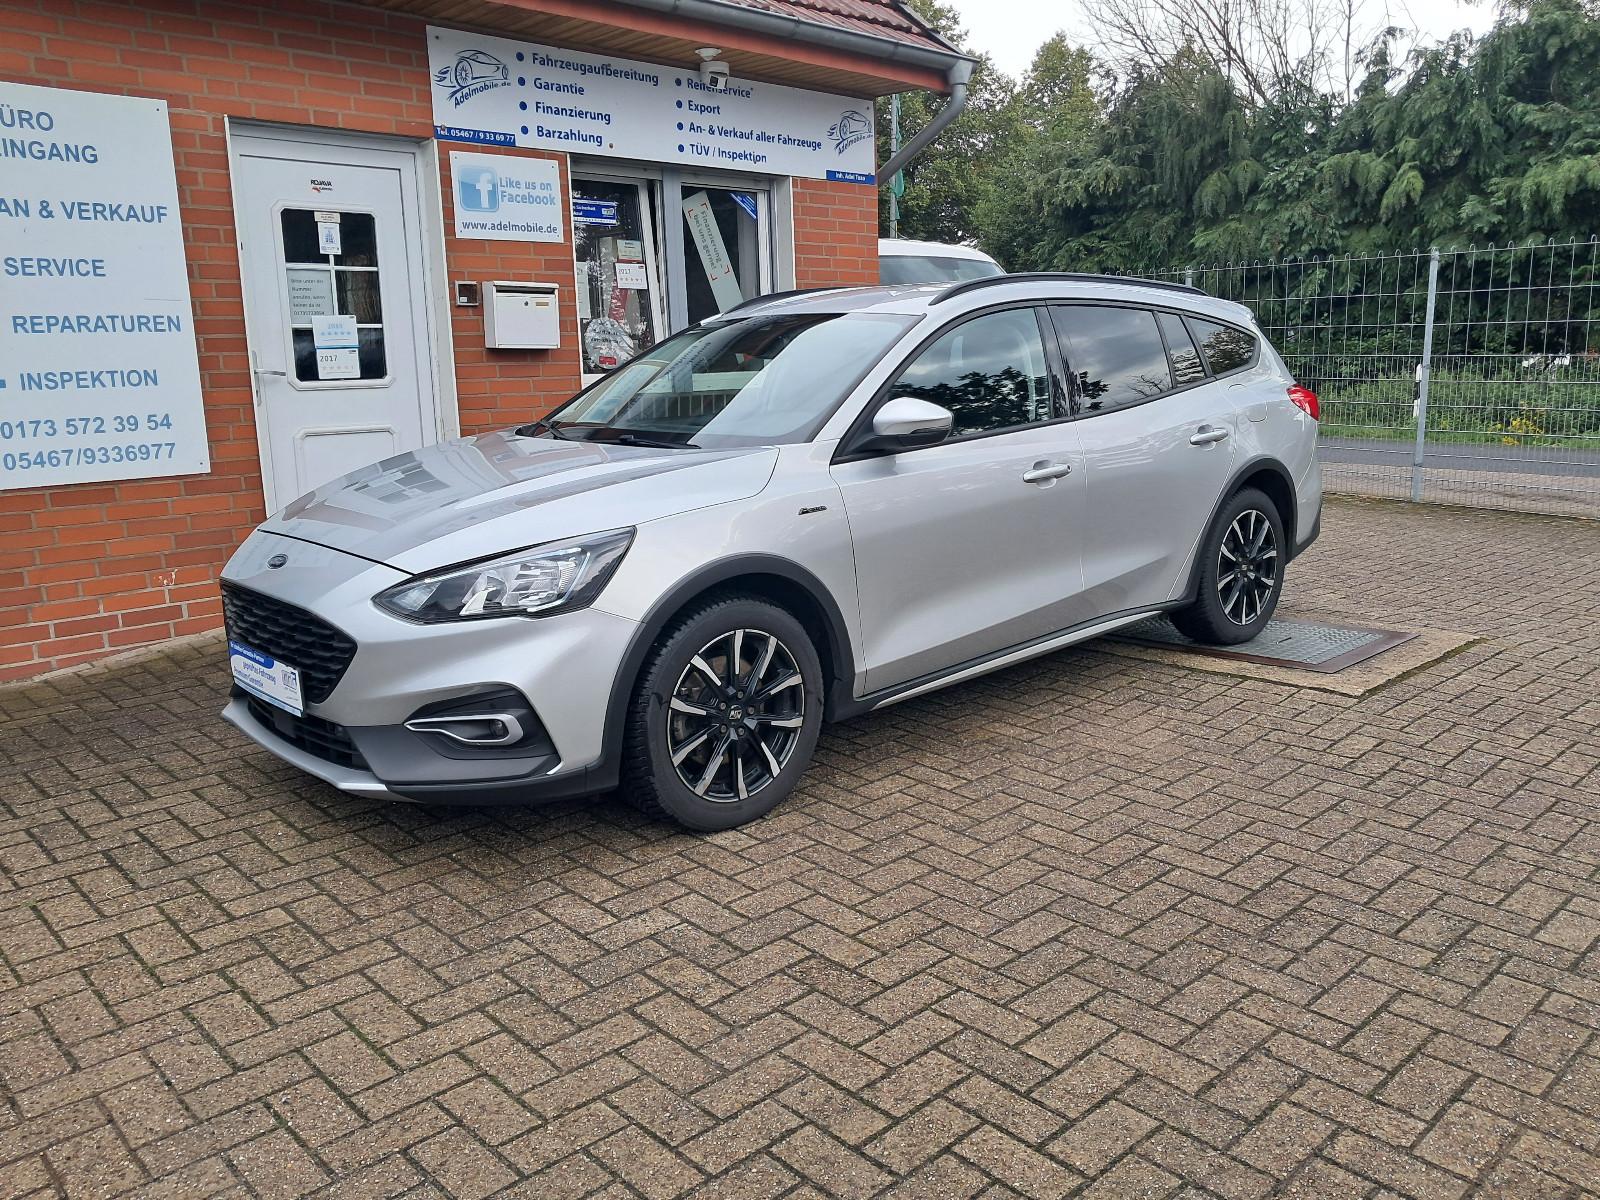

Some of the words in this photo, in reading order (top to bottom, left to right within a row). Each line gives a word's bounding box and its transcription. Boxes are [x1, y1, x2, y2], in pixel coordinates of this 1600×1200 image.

[532, 53, 659, 86] Fahrzeugaufbereitung
[453, 81, 512, 109] Adelmobile.de
[533, 77, 585, 95] Garantie
[535, 101, 611, 125] Finanzierung
[688, 99, 720, 115] Export
[451, 129, 474, 138] 05467
[536, 125, 603, 146] Barzahlung
[689, 122, 706, 134] An-
[708, 125, 716, 135] &
[717, 126, 753, 141] Verkauf
[755, 131, 776, 144] aller
[777, 135, 822, 150] Fahrzeuge
[0, 138, 98, 163] INGANG
[689, 143, 710, 157] TÜV
[718, 147, 767, 164] Inspektion
[499, 177, 521, 190] Like
[525, 181, 537, 191] us
[540, 182, 552, 192] on
[500, 191, 556, 206] Facebook
[0, 198, 30, 218] AN
[38, 200, 55, 219] &
[60, 200, 168, 224] VERKAUF
[462, 221, 558, 234] www.adelmobile.de
[4, 256, 107, 278] SERVICE
[12, 315, 182, 333] REPARATUREN
[20, 369, 159, 391] INSPEKTION
[0, 419, 57, 440] 0173
[65, 416, 107, 436] 572
[113, 414, 139, 433] 39
[146, 413, 173, 431] 54
[3, 442, 176, 471] 05467/9336977
